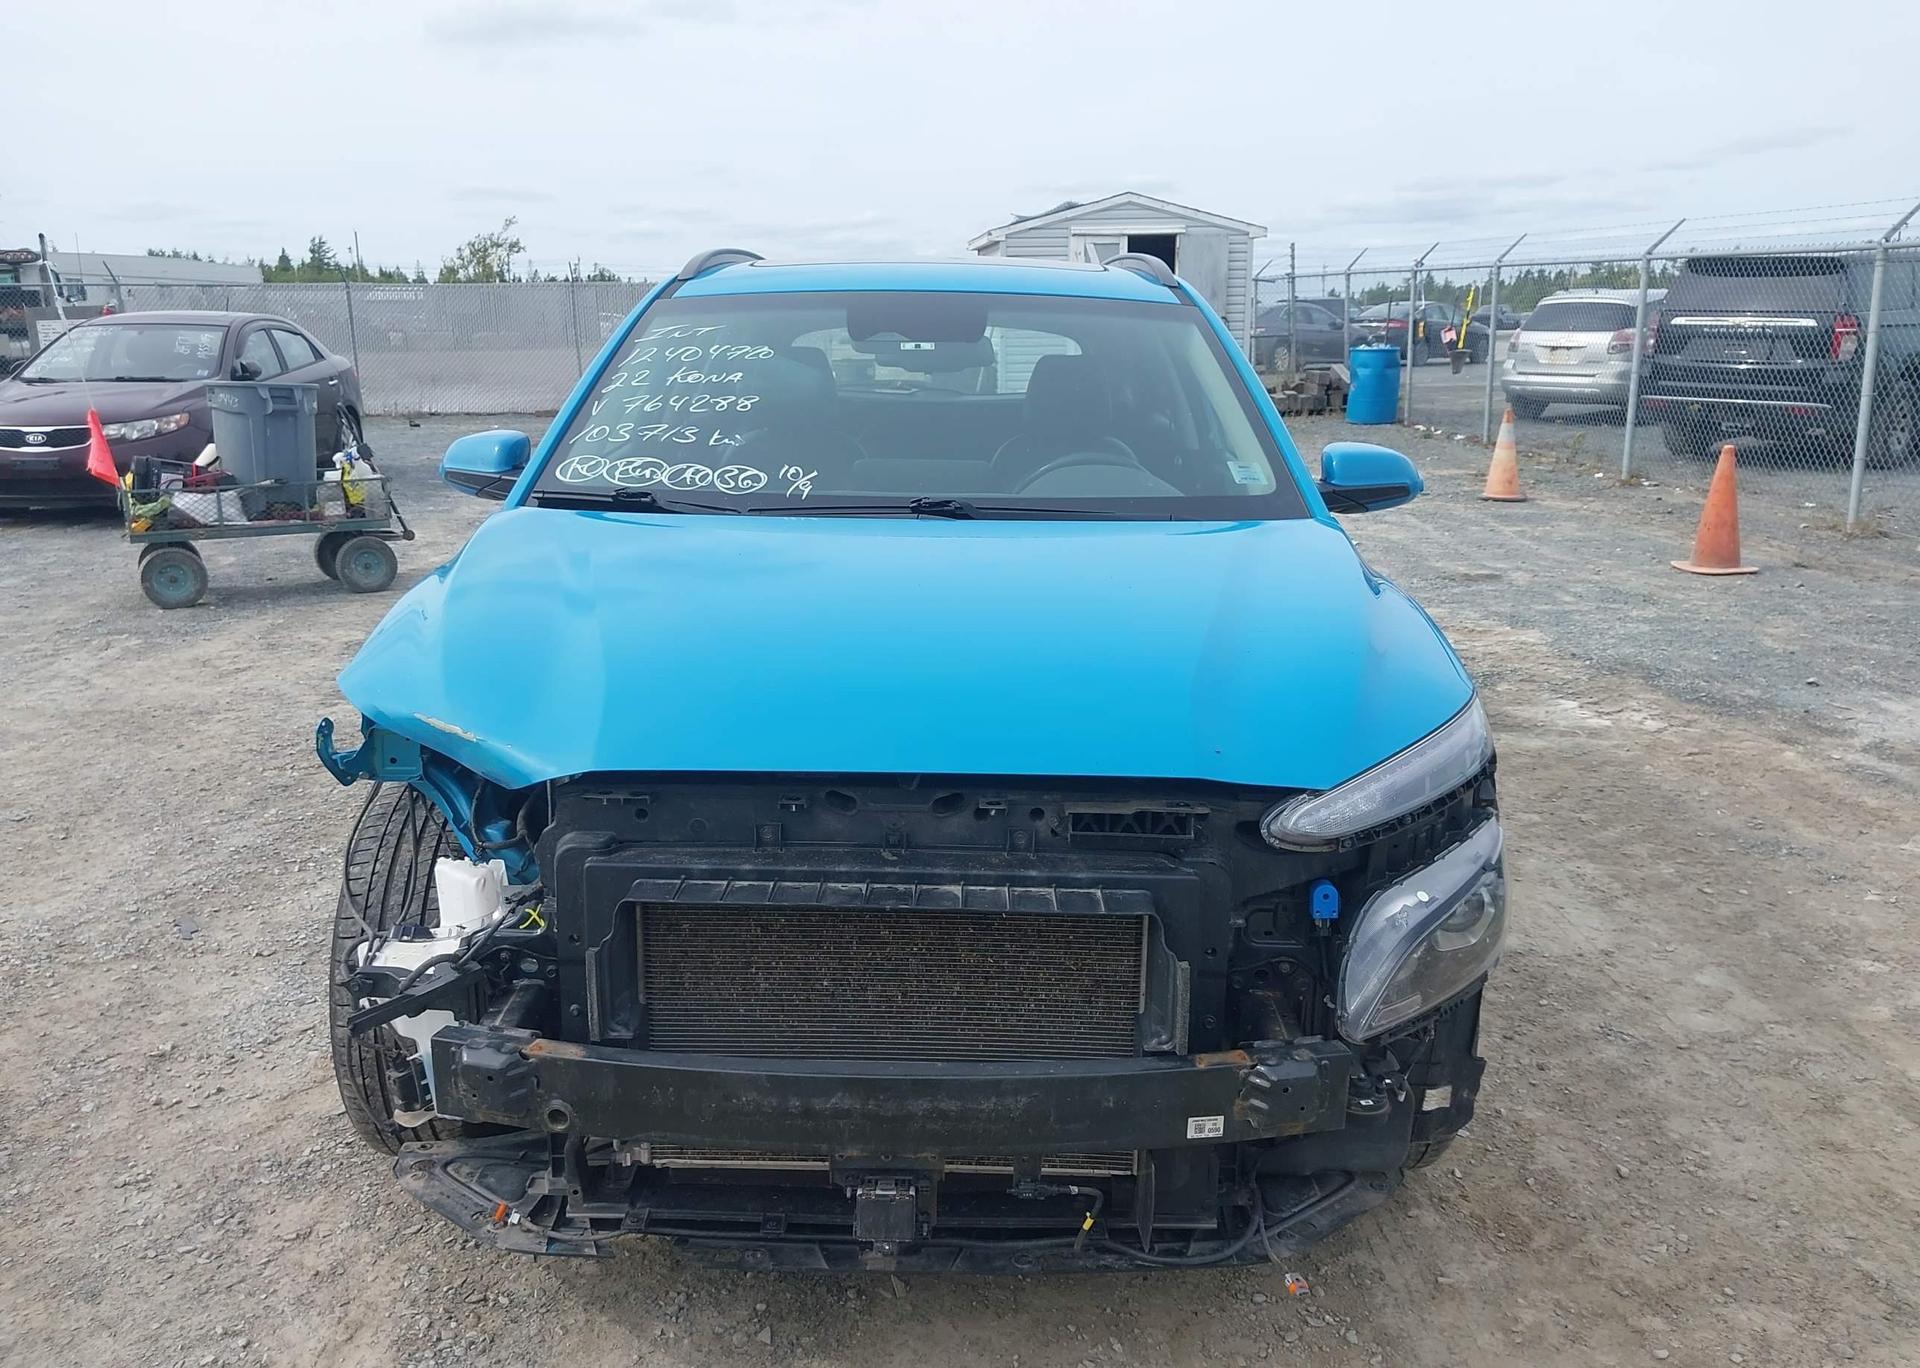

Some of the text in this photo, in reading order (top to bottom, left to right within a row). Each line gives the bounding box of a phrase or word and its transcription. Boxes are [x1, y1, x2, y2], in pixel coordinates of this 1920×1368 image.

[601, 366, 743, 393] 22 KONA
[622, 394, 760, 414] 764288
[28, 434, 44, 443] KIA
[569, 423, 699, 444] 103713
